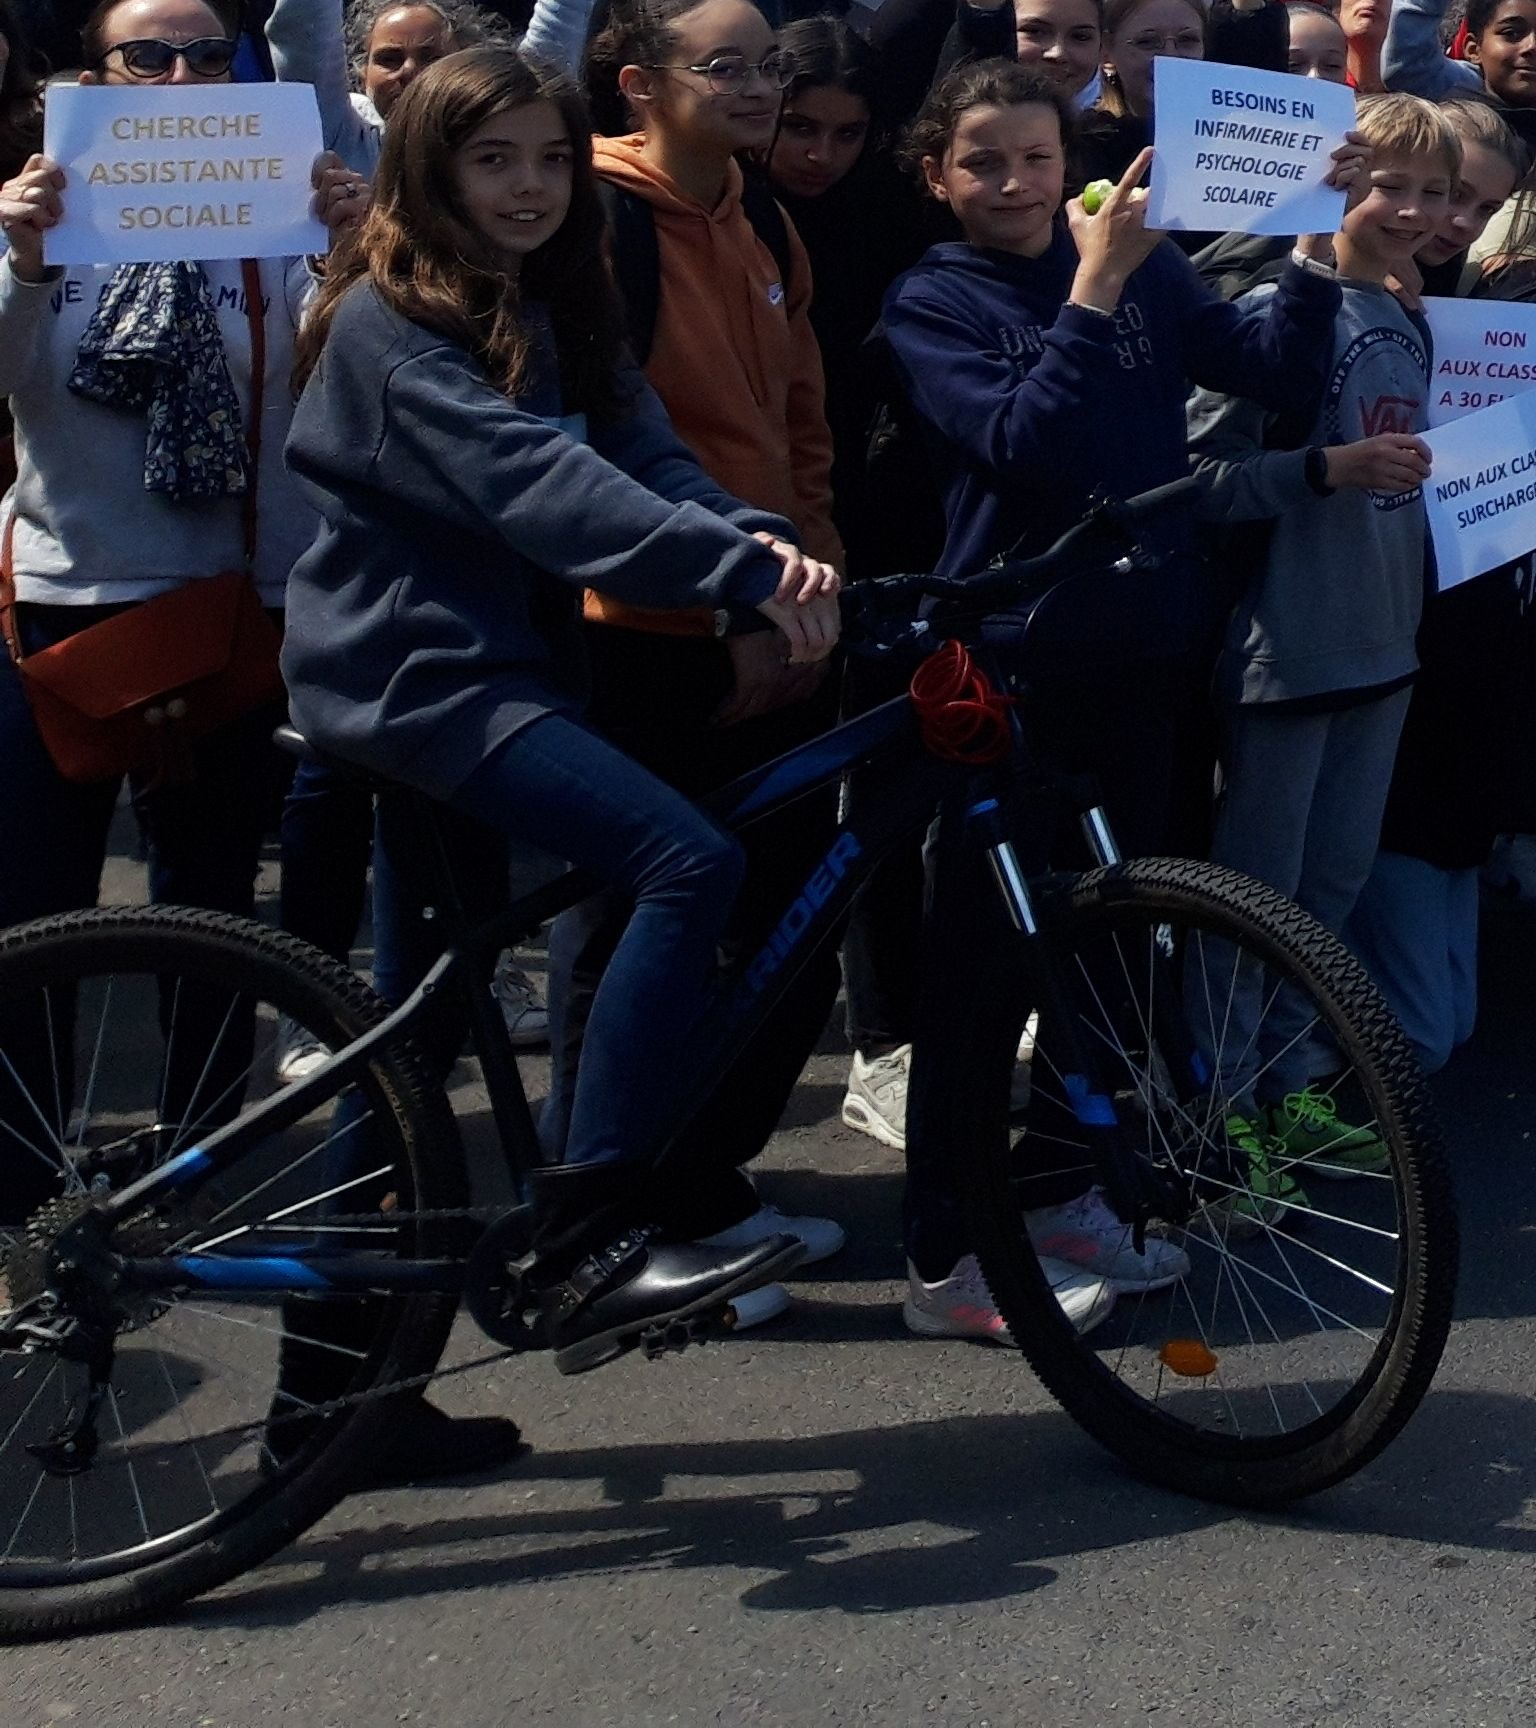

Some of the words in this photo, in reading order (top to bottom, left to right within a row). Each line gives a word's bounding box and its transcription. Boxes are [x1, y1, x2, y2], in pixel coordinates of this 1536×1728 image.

[1211, 89, 1287, 114] BESOINS
[1292, 101, 1314, 119] EN
[111, 114, 262, 140] CHERCHE
[1194, 119, 1299, 148] INFIRMIERIE
[1301, 134, 1323, 152] ET
[88, 157, 284, 186] ASSISTANTE
[1195, 152, 1308, 181] PSYCHOLOGIE
[1202, 185, 1278, 208] SCOLAIRE
[118, 202, 252, 230] SOCIALE
[1484, 330, 1527, 348] NON
[1439, 359, 1481, 377] AUX
[1439, 391, 1453, 406] A
[1458, 391, 1482, 408] 30
[1436, 475, 1471, 503] NON
[1475, 463, 1508, 489] AUX
